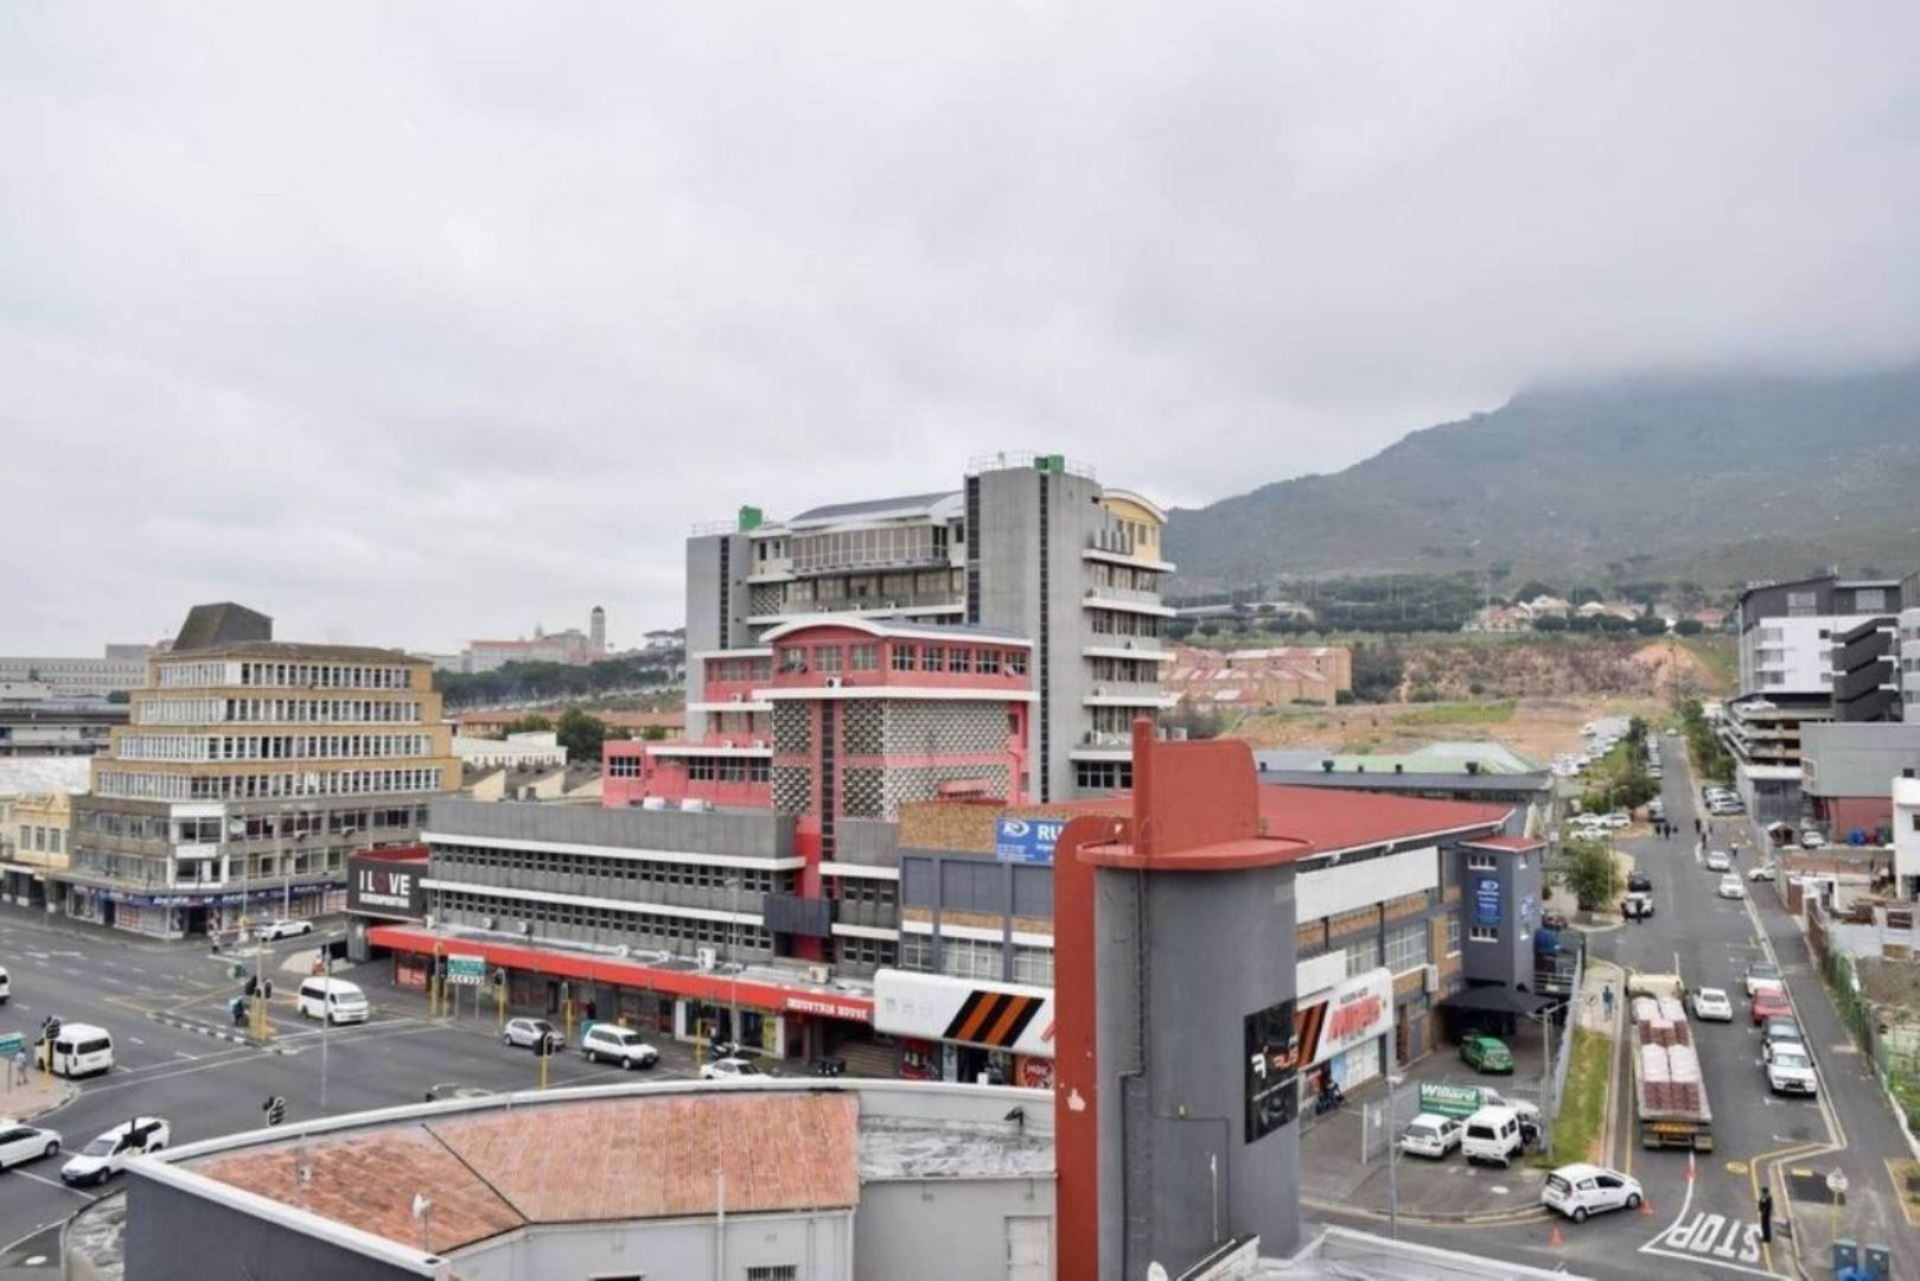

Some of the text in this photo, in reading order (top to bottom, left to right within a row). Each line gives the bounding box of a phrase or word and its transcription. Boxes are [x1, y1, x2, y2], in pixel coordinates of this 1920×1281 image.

[359, 870, 365, 891] I
[1421, 1083, 1477, 1101] Willard
[1665, 1212, 1763, 1262] STOP
